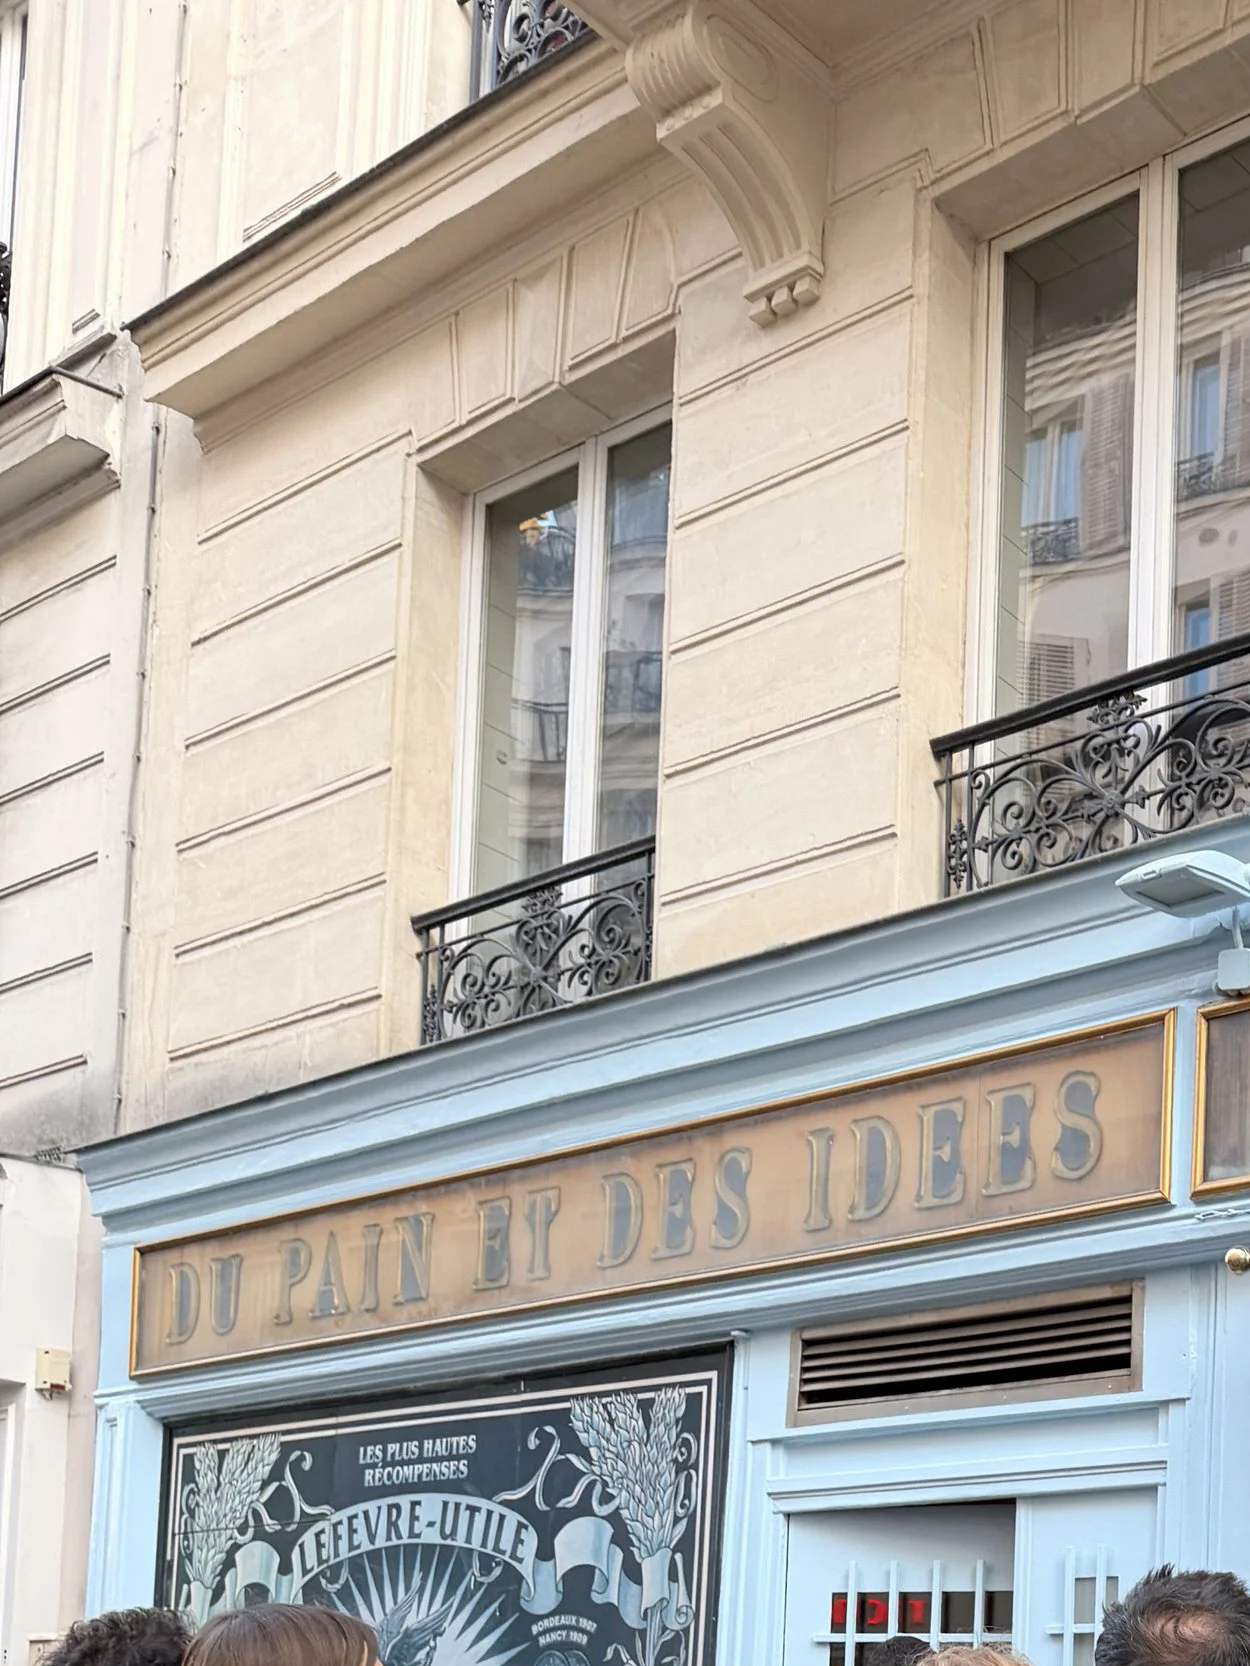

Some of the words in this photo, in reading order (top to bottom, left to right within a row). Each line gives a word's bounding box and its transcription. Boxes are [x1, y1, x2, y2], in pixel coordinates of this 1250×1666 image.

[165, 1253, 244, 1345] DU
[274, 1211, 435, 1325] PAIN
[471, 1186, 561, 1292] ET
[597, 1146, 753, 1268] DES
[802, 1070, 1102, 1232] IDEES
[358, 1443, 383, 1464] LES
[386, 1439, 419, 1462] PLUS
[423, 1434, 477, 1458] HAUTES
[363, 1459, 469, 1487] RÉCOMPENSES
[298, 1499, 530, 1579] LEFEVRE-UTILE
[531, 1614, 578, 1636] BORDEAUX
[579, 1616, 598, 1635] 1907
[537, 1629, 568, 1648] NANCY
